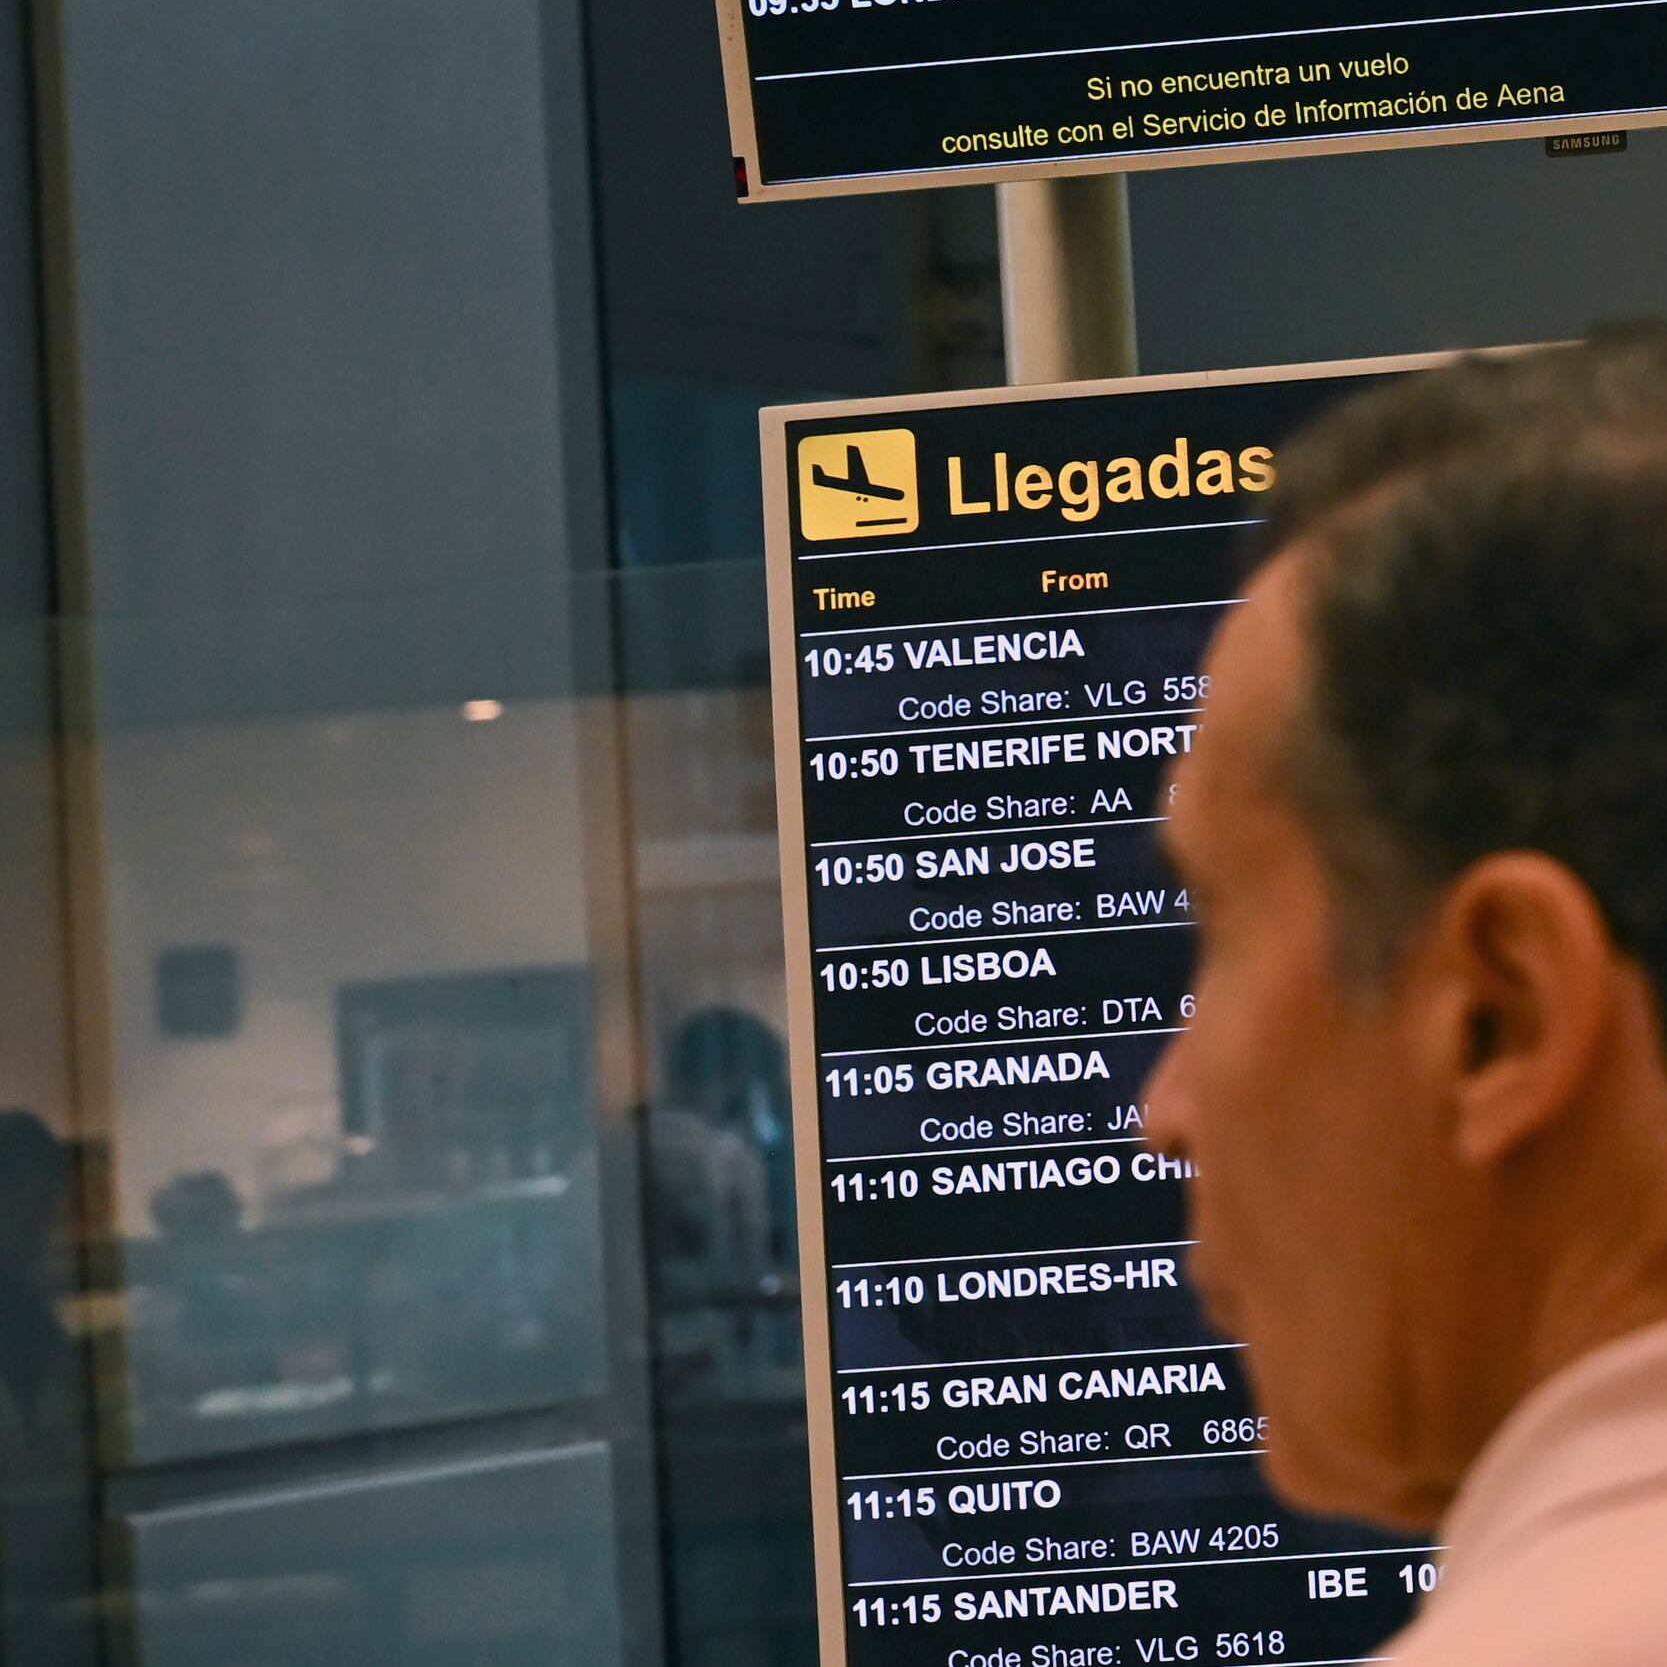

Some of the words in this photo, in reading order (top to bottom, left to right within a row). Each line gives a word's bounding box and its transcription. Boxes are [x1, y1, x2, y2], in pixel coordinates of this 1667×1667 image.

[1087, 77, 1112, 101] Si
[1120, 78, 1153, 98] no
[1160, 64, 1291, 94] encuentra
[1298, 63, 1331, 83] un
[1338, 52, 1409, 79] vuelo
[941, 124, 1049, 154] consulte
[1057, 123, 1104, 144] con
[1112, 115, 1134, 140] el
[1143, 111, 1246, 137] Servicio
[1254, 103, 1287, 127] de
[1295, 94, 1448, 125] Información
[1455, 86, 1488, 111] de
[1497, 83, 1565, 108] Aena
[1552, 134, 1621, 150] SAMSUNG
[947, 437, 1278, 523] Llegadas
[812, 587, 876, 611] Time
[1041, 569, 1109, 593] From
[804, 642, 895, 678] 10:45
[902, 628, 1086, 670] VALENCIA
[898, 693, 972, 721] Code
[980, 689, 1070, 715] Share:
[1083, 679, 1147, 708] VLG
[835, 1275, 925, 1309] 11:10
[937, 1258, 1179, 1303] LONDRES-HR
[846, 1486, 937, 1521] 11:15
[947, 1479, 1062, 1515] QUITO
[942, 1540, 1016, 1568] Code
[1025, 1536, 1115, 1563] Share:
[1131, 1527, 1201, 1558] BAW
[1208, 1522, 1280, 1552] 4205
